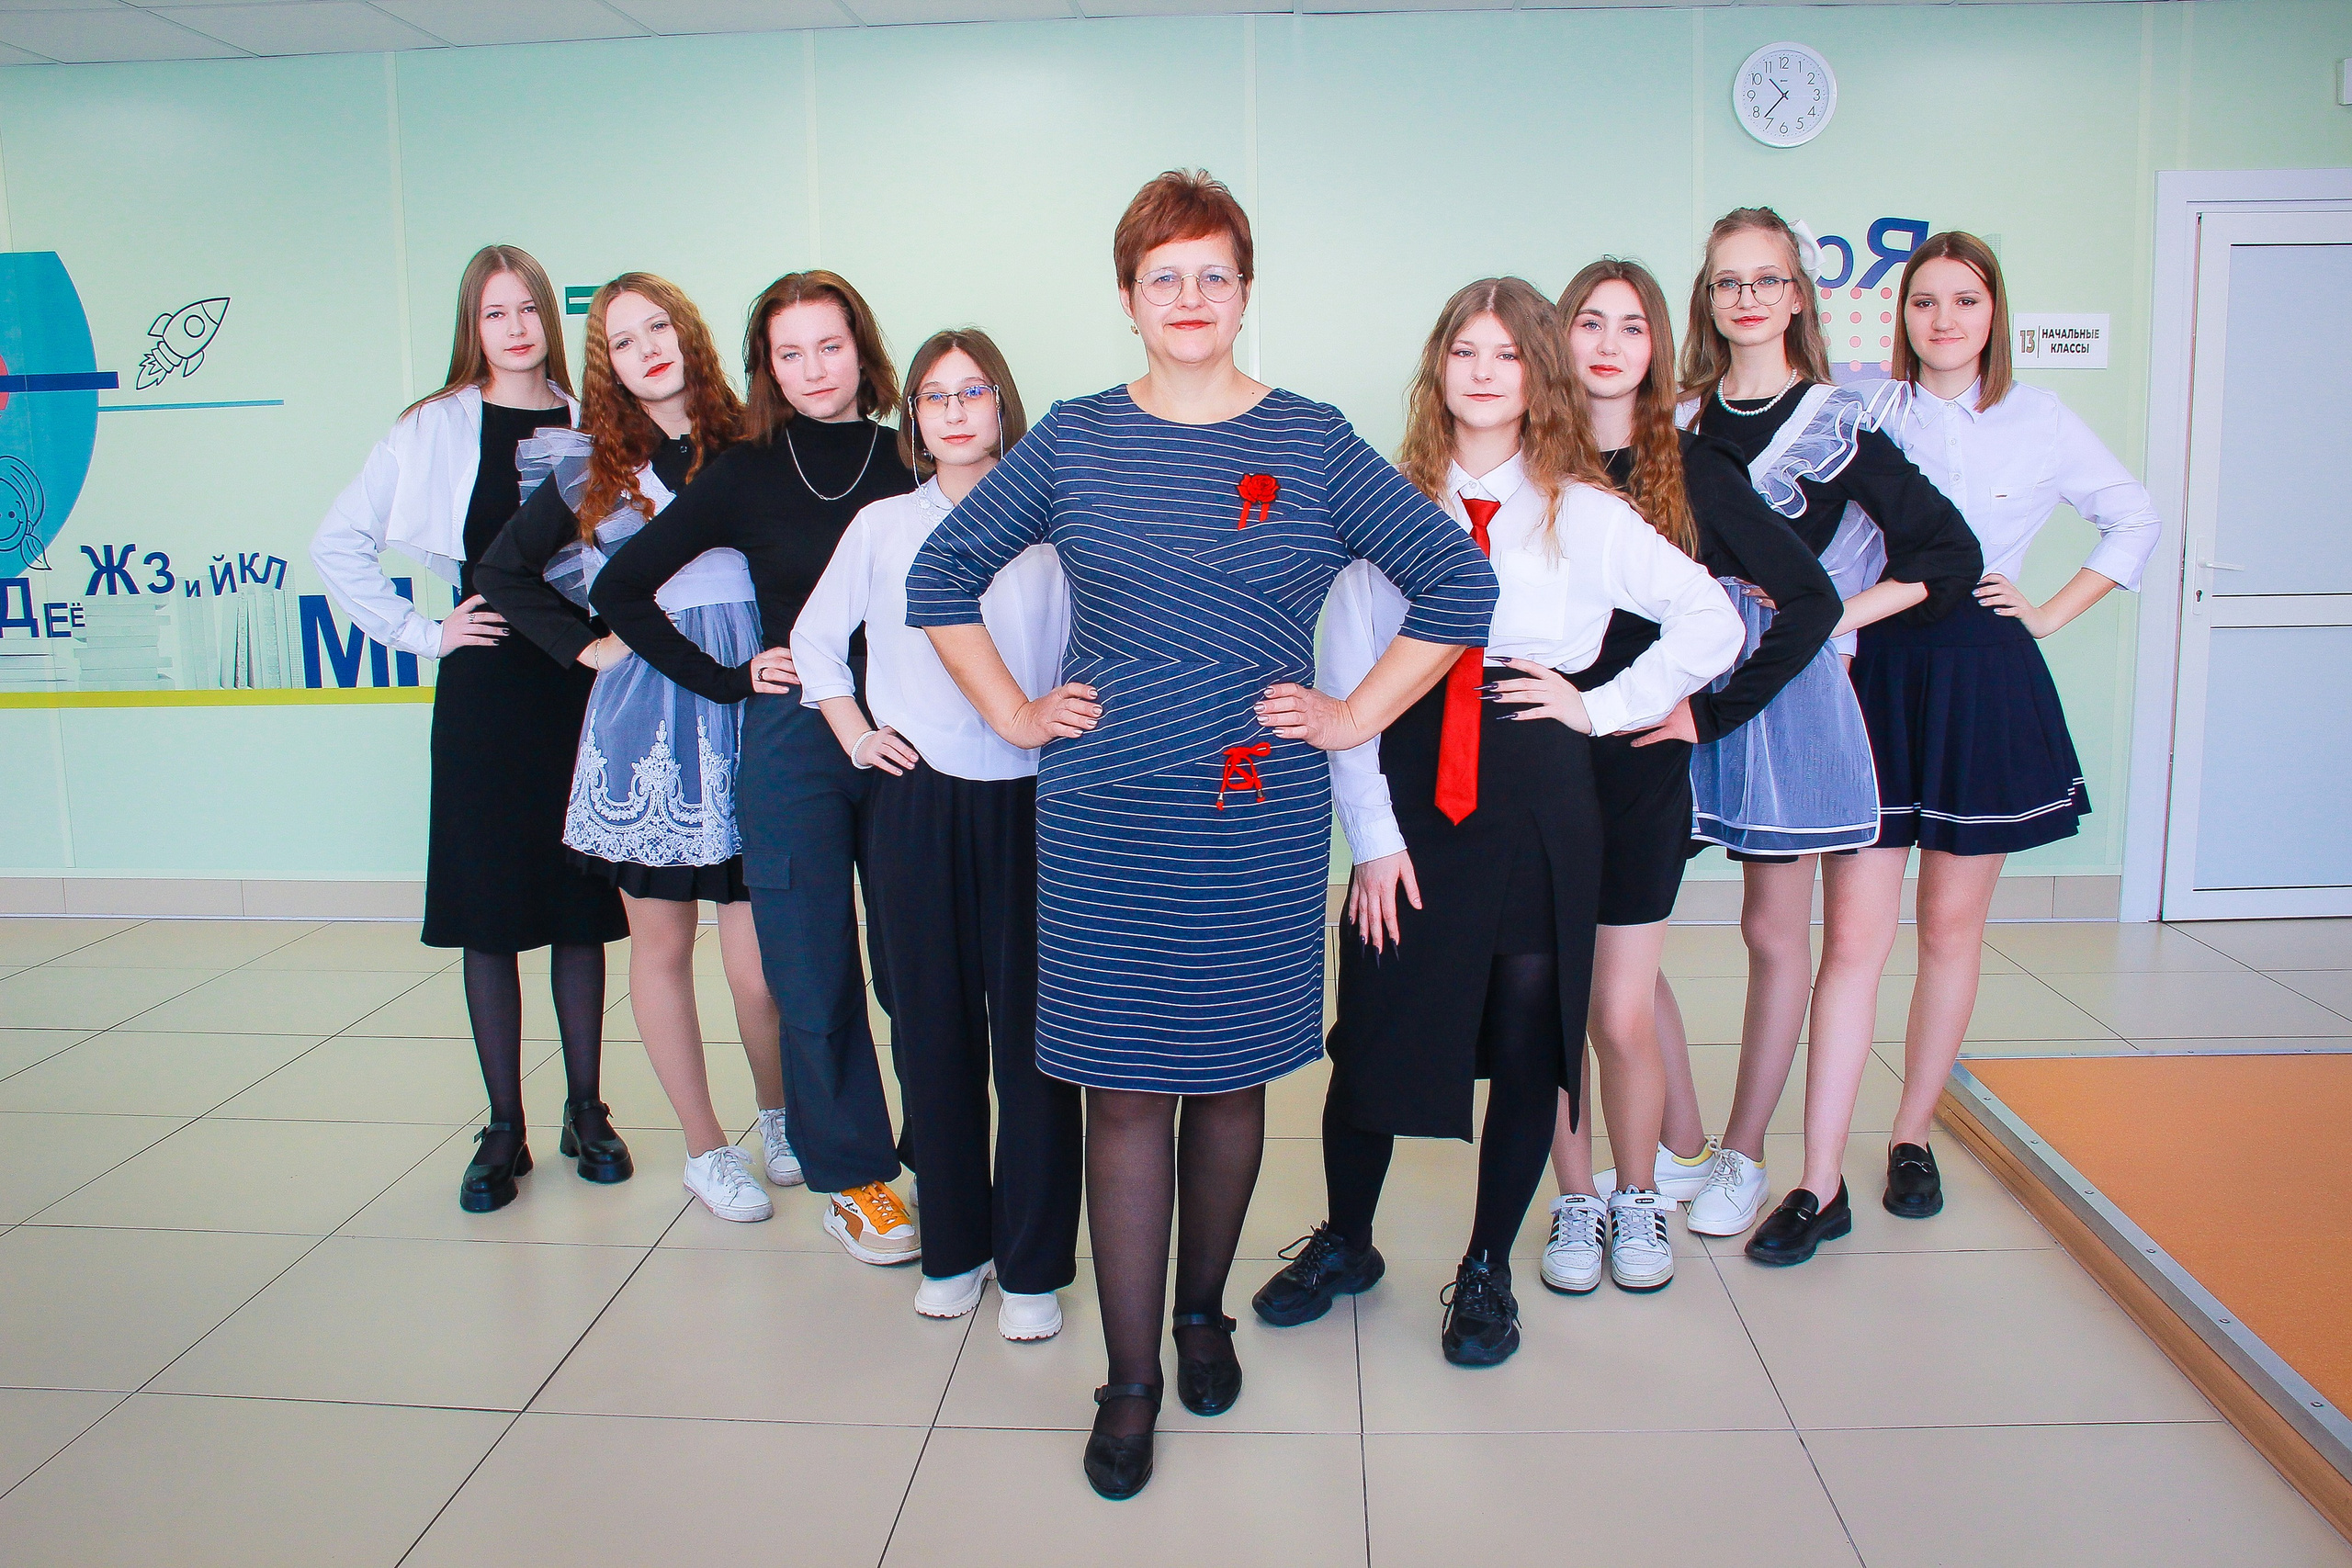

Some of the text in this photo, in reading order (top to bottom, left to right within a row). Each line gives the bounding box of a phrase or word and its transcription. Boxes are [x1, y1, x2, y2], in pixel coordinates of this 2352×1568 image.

[1764, 61, 1772, 73] 11
[1779, 56, 1789, 69] 12
[1750, 73, 1763, 85] 10
[1806, 72, 1815, 85] 2
[1747, 89, 1757, 103] 9
[1813, 88, 1821, 102] 3
[1752, 105, 1760, 118] 8
[1807, 105, 1816, 118] 4
[1764, 117, 1774, 130] 7
[1779, 121, 1789, 134] 6
[1795, 117, 1804, 130] 5
[2041, 328, 2100, 340] НАЧАЛЬНЫЕ
[2019, 329, 2036, 354] 13
[2050, 343, 2090, 354] КЛАССЫ
